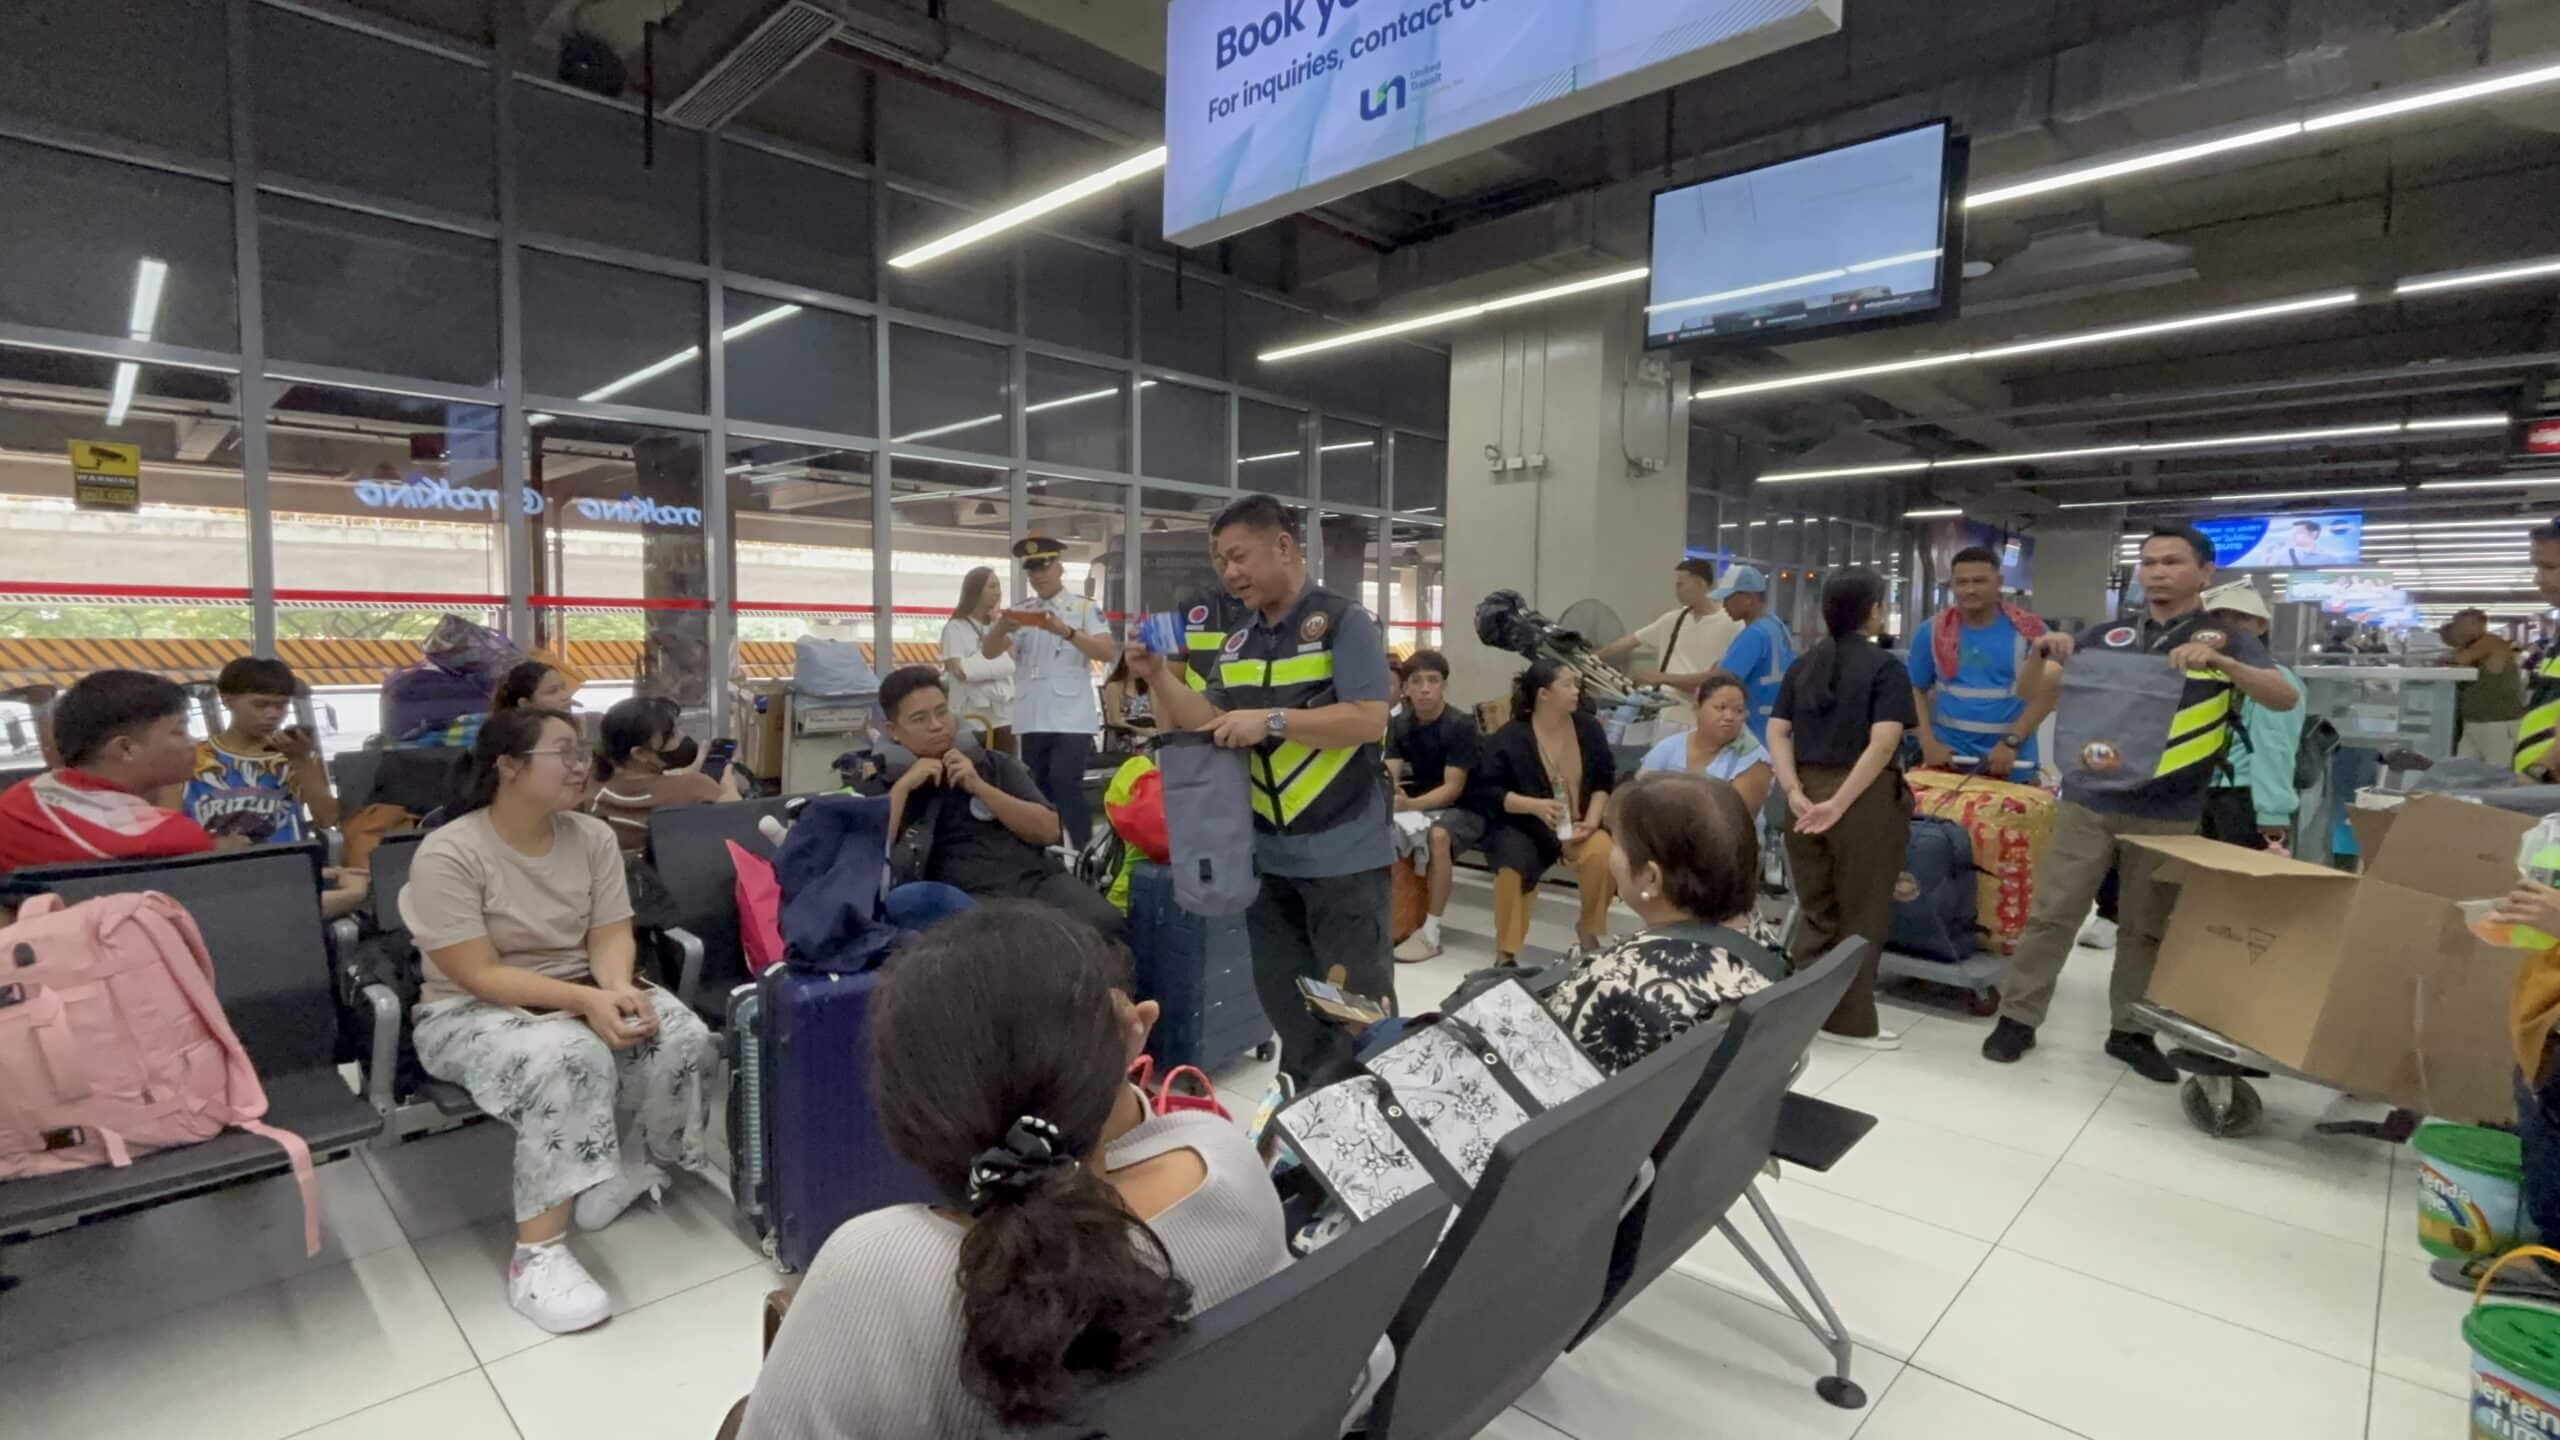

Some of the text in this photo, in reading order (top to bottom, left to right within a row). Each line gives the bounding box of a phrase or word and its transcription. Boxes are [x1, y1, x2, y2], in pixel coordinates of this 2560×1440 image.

[1209, 93, 1239, 123] For
[1243, 51, 1344, 108] inquiries,
[1350, 0, 1454, 59] contact
[1216, 0, 1306, 71] Book
